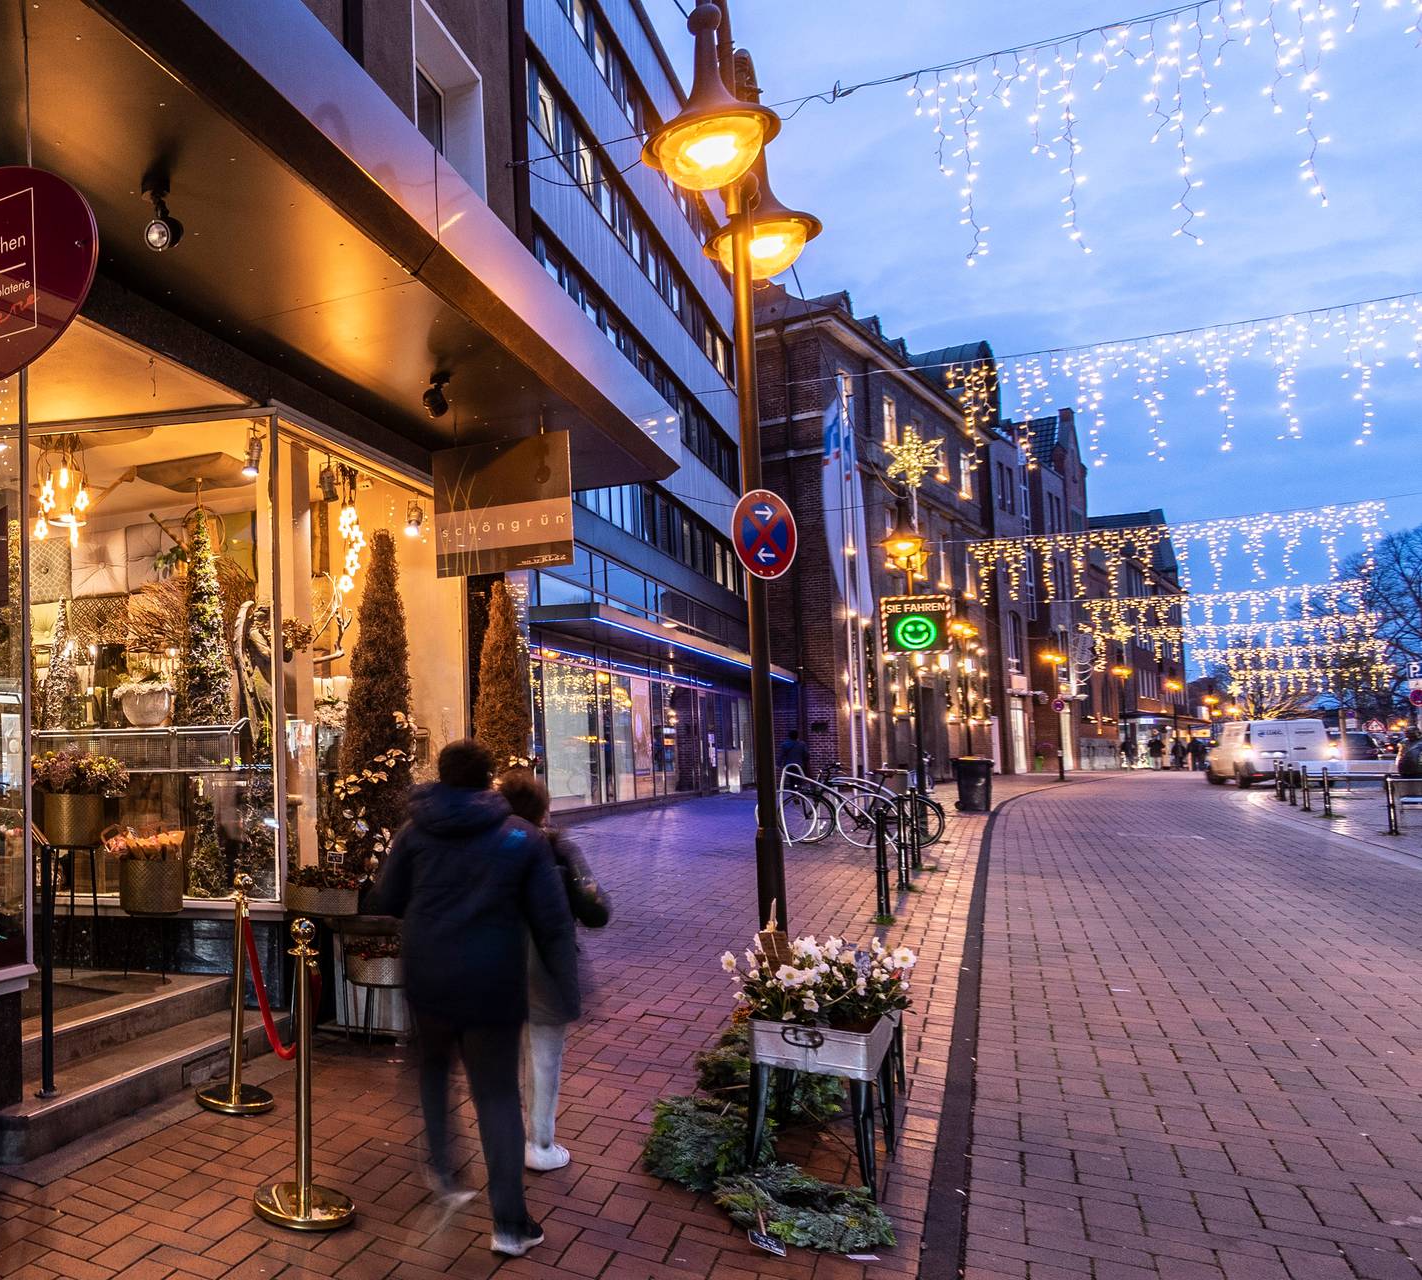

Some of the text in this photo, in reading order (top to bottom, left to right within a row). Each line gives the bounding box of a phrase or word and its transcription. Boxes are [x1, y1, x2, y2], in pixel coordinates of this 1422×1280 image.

[442, 513, 565, 538] schöngrün
[886, 602, 946, 614] SIE FAHREN
[1409, 664, 1420, 678] P
